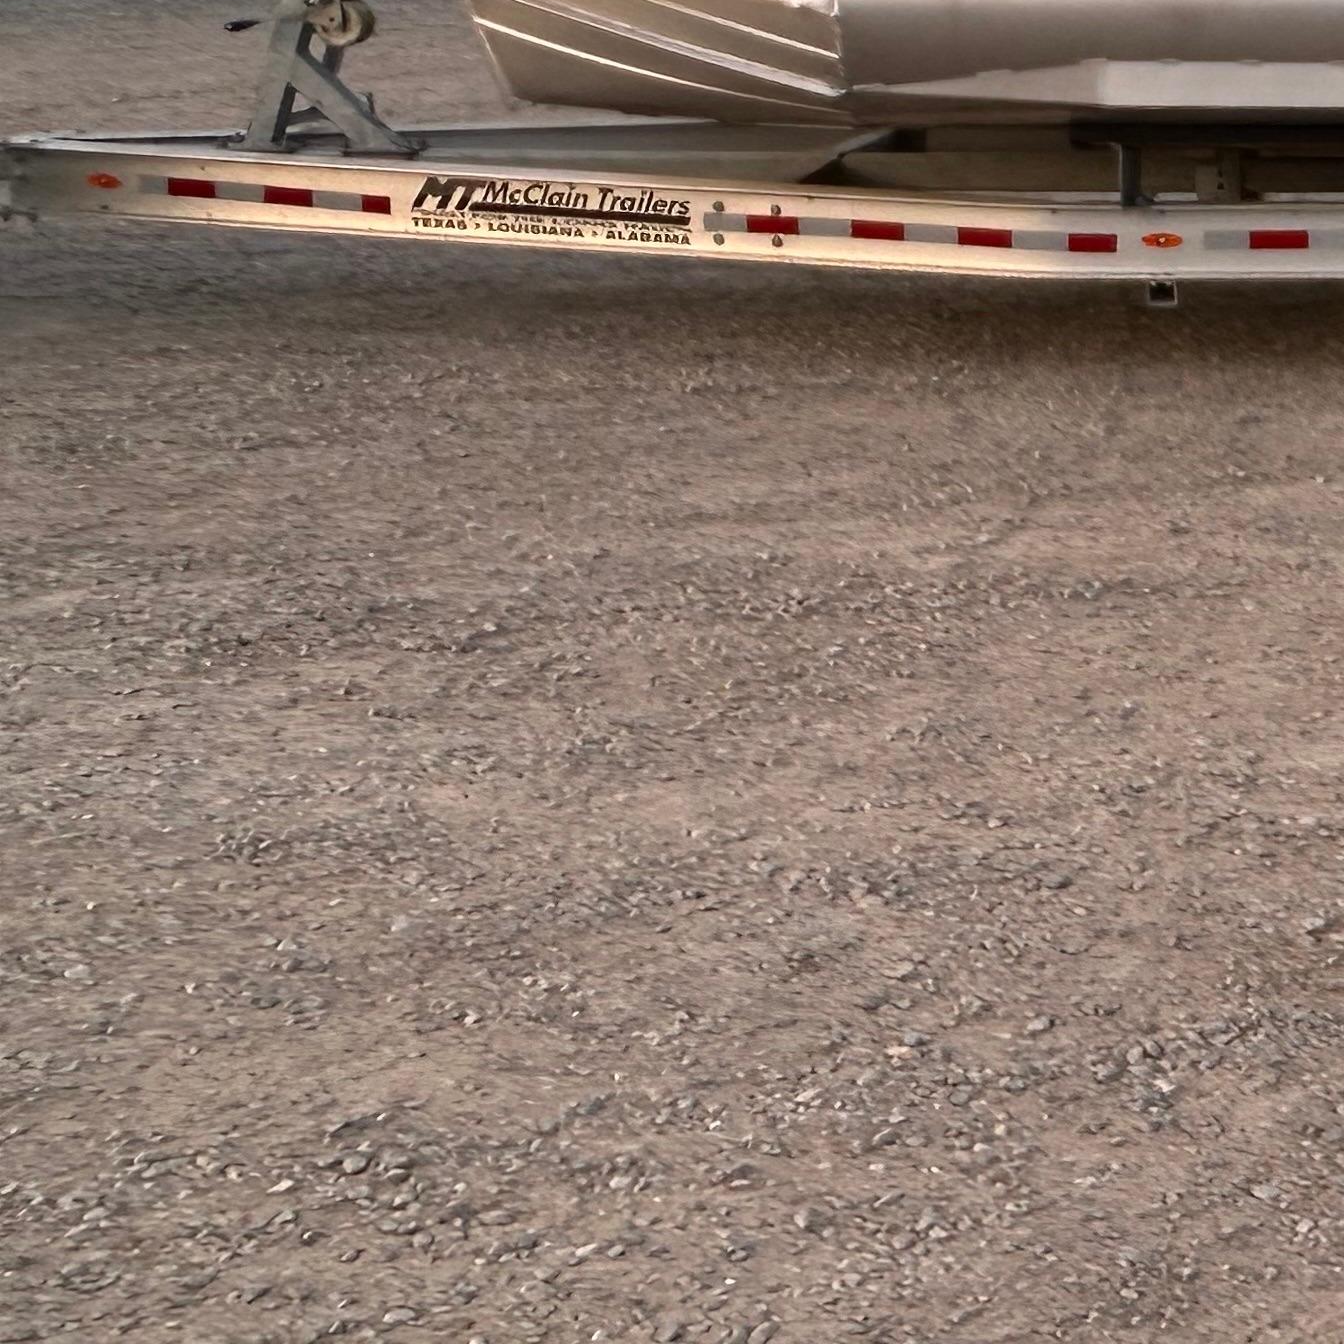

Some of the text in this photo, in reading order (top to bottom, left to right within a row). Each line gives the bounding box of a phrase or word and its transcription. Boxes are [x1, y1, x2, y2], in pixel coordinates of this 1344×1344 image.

[482, 180, 690, 215] McClain Trailers
[411, 216, 468, 231] TEXAS
[487, 222, 585, 238] LOUISIANA
[605, 230, 692, 246] ALABAMA
